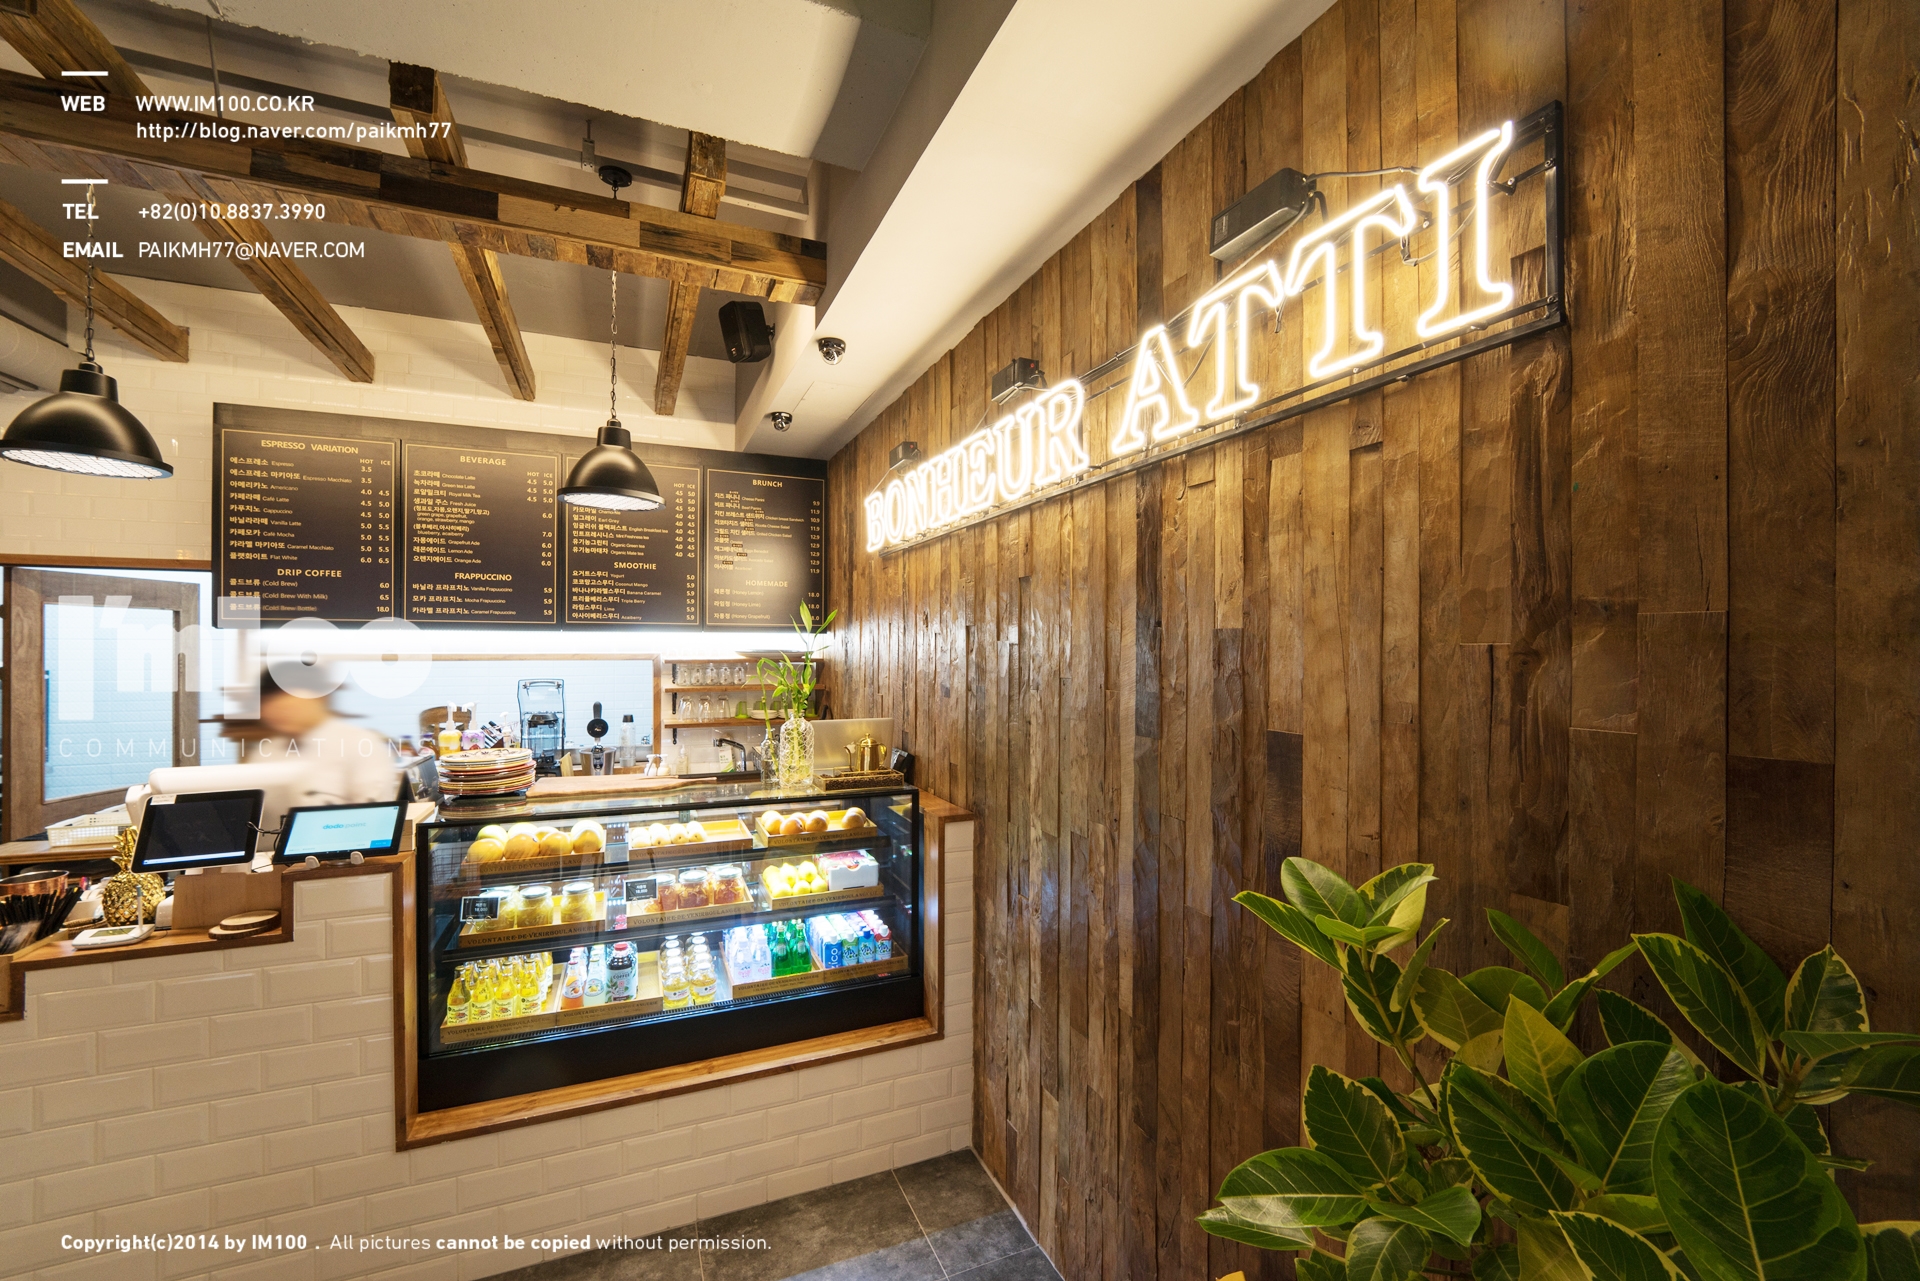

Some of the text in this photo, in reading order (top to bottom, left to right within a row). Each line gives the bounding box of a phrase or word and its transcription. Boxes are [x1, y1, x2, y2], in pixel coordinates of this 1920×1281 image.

[865, 121, 1513, 553] BONHEUR ATTI
[261, 440, 358, 454] ESPRESSO VARIATION
[230, 456, 269, 465] 에스프레소
[460, 455, 507, 466] BEVERAGE
[230, 468, 269, 477] 에스프레소
[270, 470, 300, 479] 마키아또
[413, 470, 441, 478] 초코라떼
[230, 480, 269, 489] 아메리카노
[413, 479, 441, 487] 녹차라떼
[752, 479, 783, 488] BRUNCH
[230, 492, 261, 501] 카페라떼
[413, 488, 447, 496] 로얄밀크티
[230, 504, 261, 513] 카푸치노
[230, 516, 269, 525] 바닐라라떼
[230, 528, 261, 537] 카페모카
[230, 552, 268, 560] 플랫화이트
[614, 561, 657, 570] SMOOTHIE
[277, 568, 343, 578] DRIP COFFEE
[454, 572, 513, 581] FRAPPUCCINO
[412, 583, 434, 591] 바닐라
[745, 580, 788, 588] HOMEMADE
